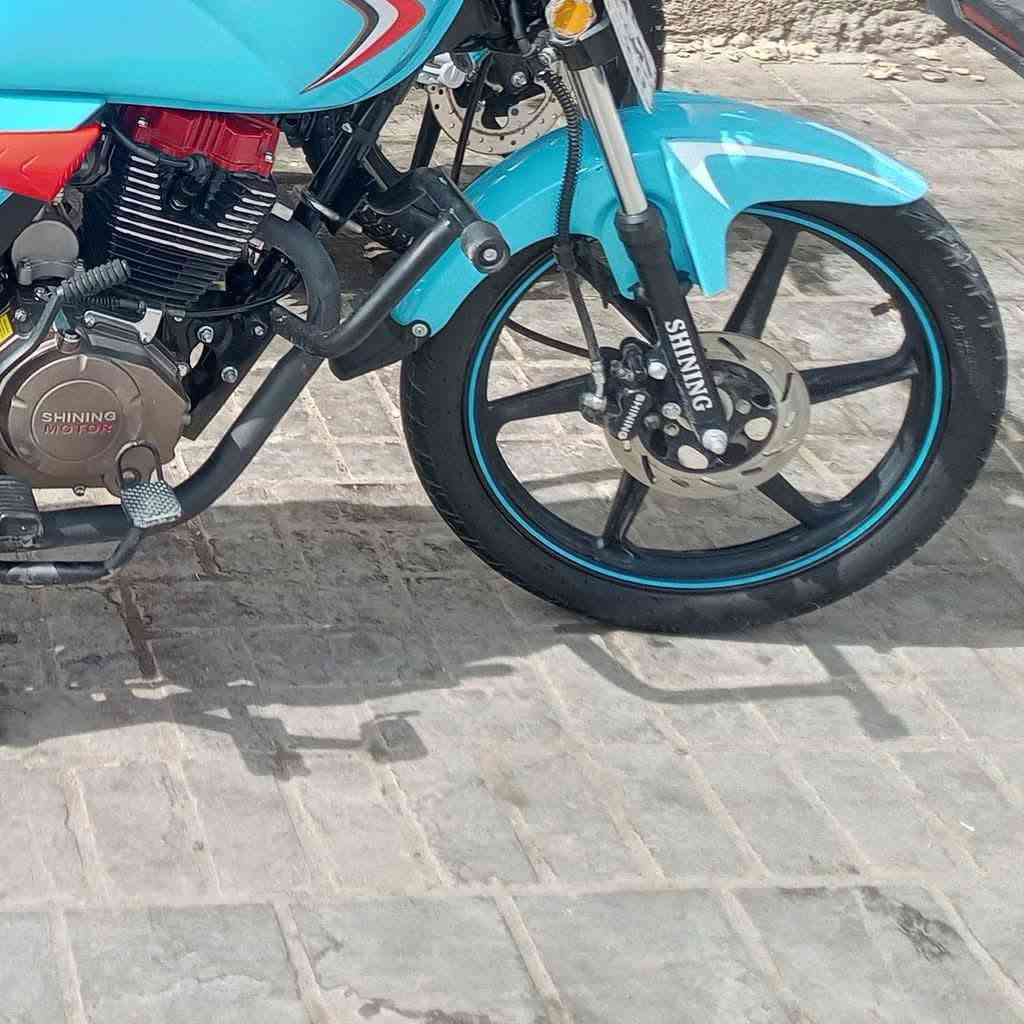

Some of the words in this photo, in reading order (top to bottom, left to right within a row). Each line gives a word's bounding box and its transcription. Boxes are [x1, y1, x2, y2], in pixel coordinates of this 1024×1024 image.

[664, 318, 713, 412] SHINING
[41, 411, 116, 423] SHINING
[44, 423, 113, 434] MOTOR
